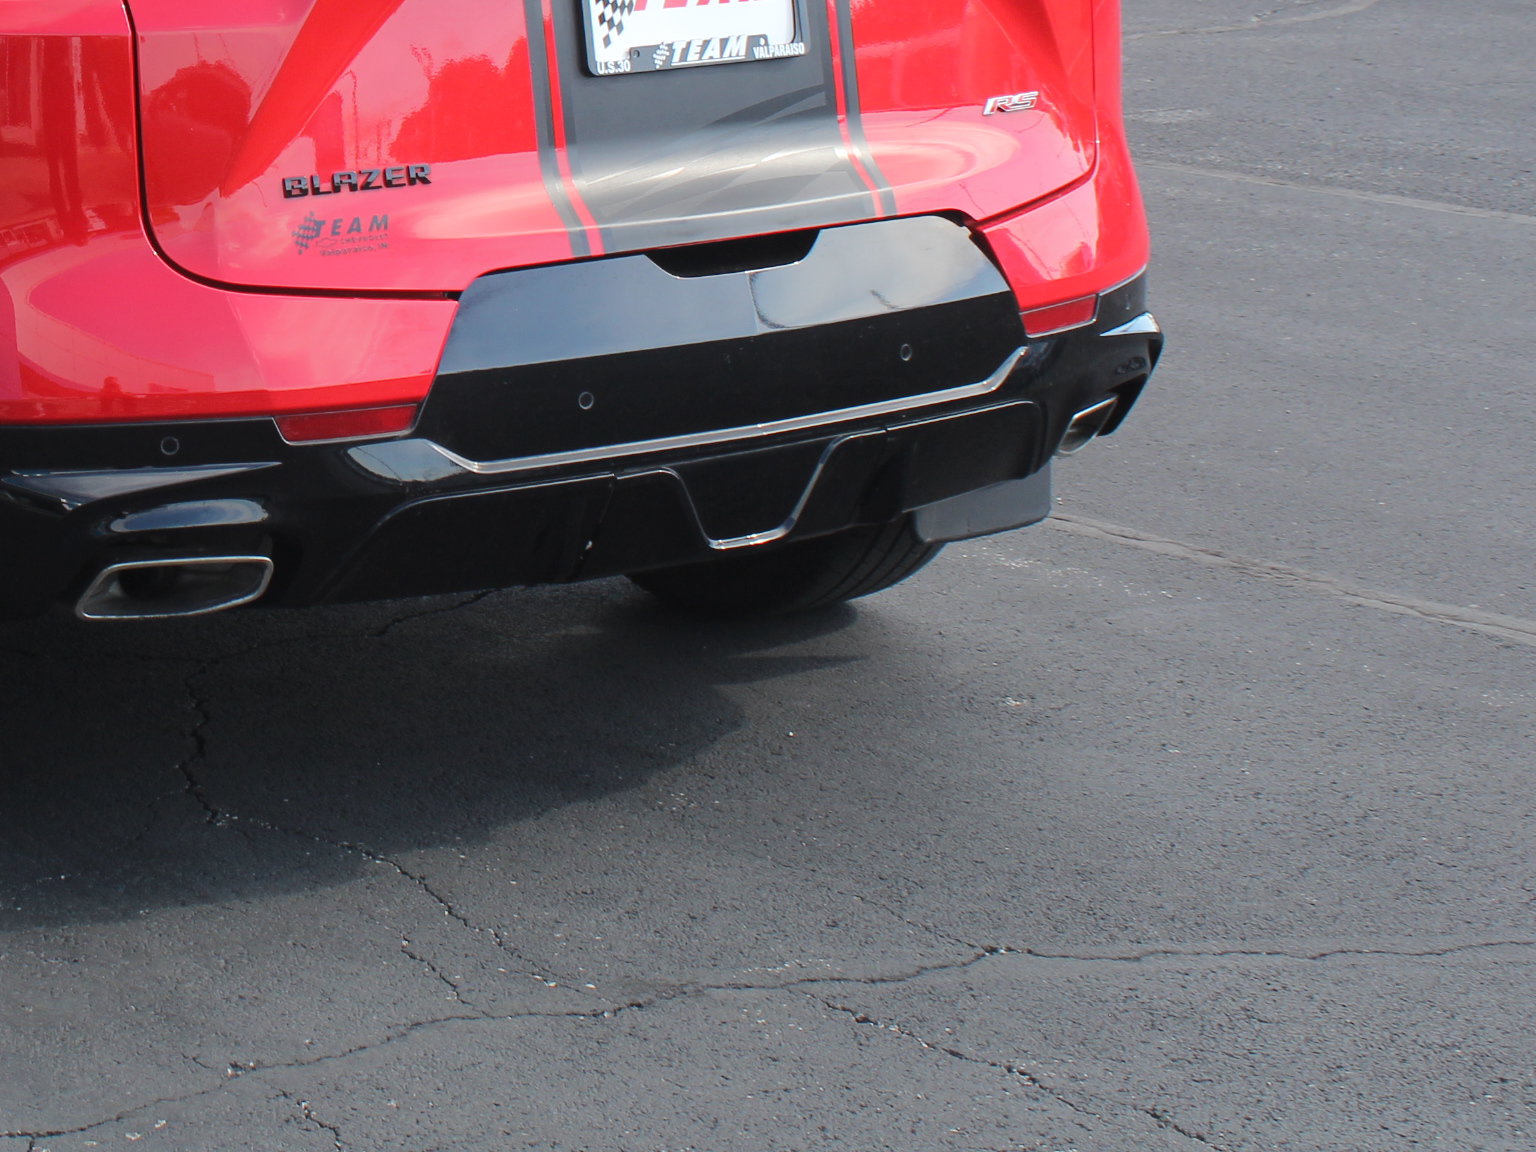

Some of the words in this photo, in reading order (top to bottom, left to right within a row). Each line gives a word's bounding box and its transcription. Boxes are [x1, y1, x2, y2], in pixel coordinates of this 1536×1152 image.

[671, 34, 748, 64] TEAM
[753, 42, 805, 59] VALPARAISO
[982, 91, 1040, 116] RS
[282, 163, 432, 199] BLAZER
[311, 214, 389, 239] TEAM
